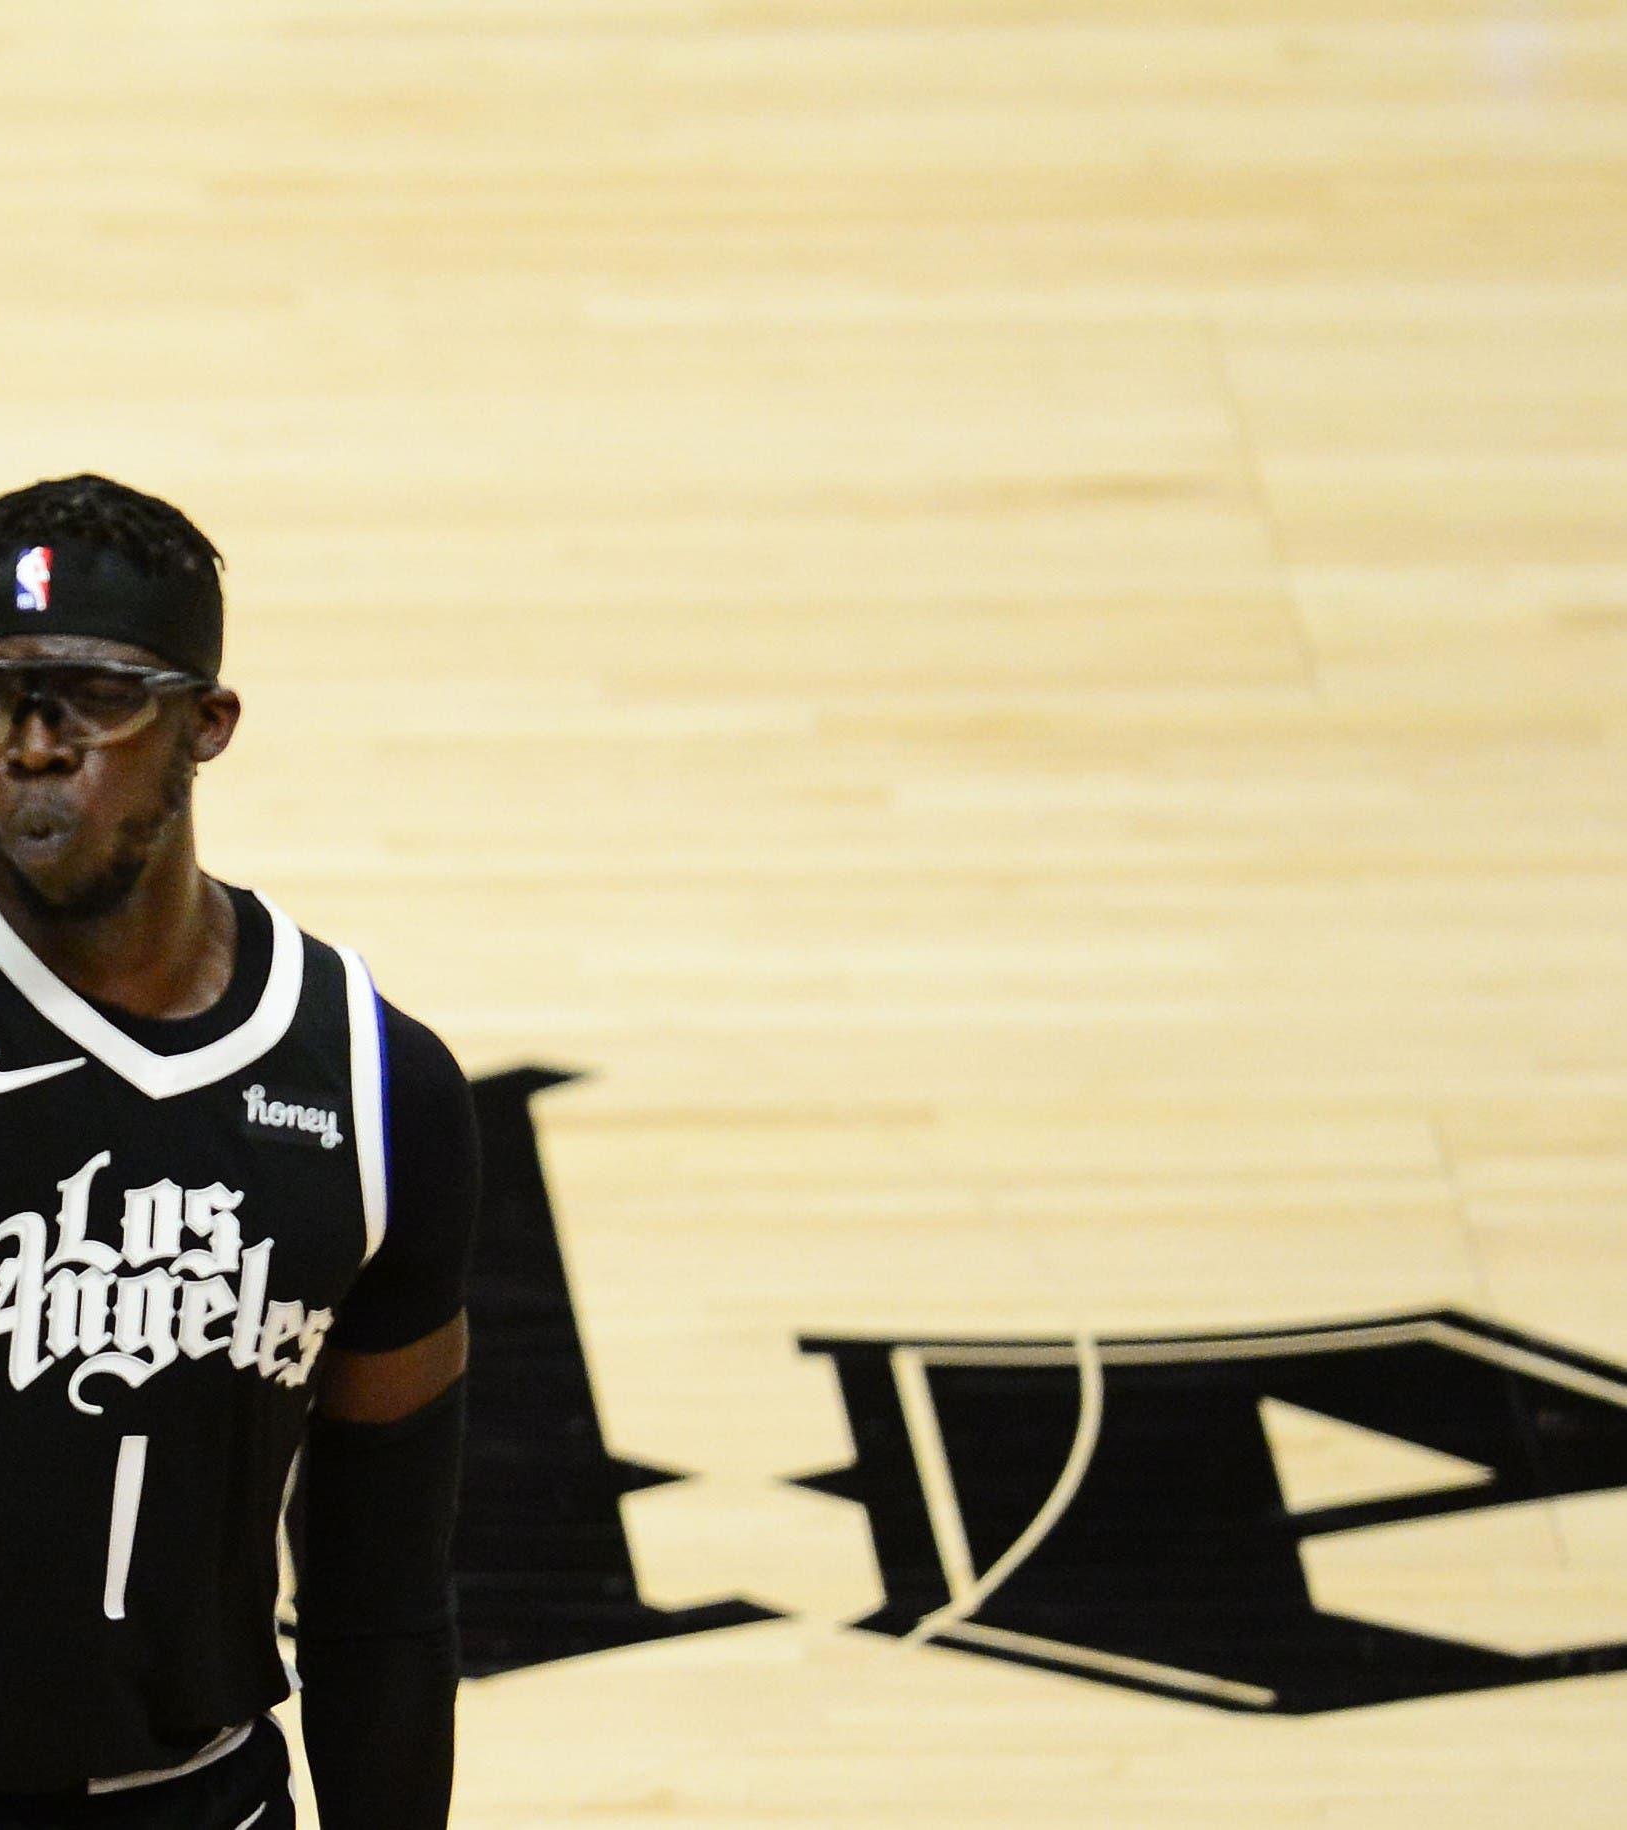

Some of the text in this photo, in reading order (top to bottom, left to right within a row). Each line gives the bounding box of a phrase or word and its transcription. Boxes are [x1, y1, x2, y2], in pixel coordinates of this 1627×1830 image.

[242, 1084, 343, 1149] honey
[46, 1150, 244, 1277] Los
[104, 1435, 148, 1619] 1
